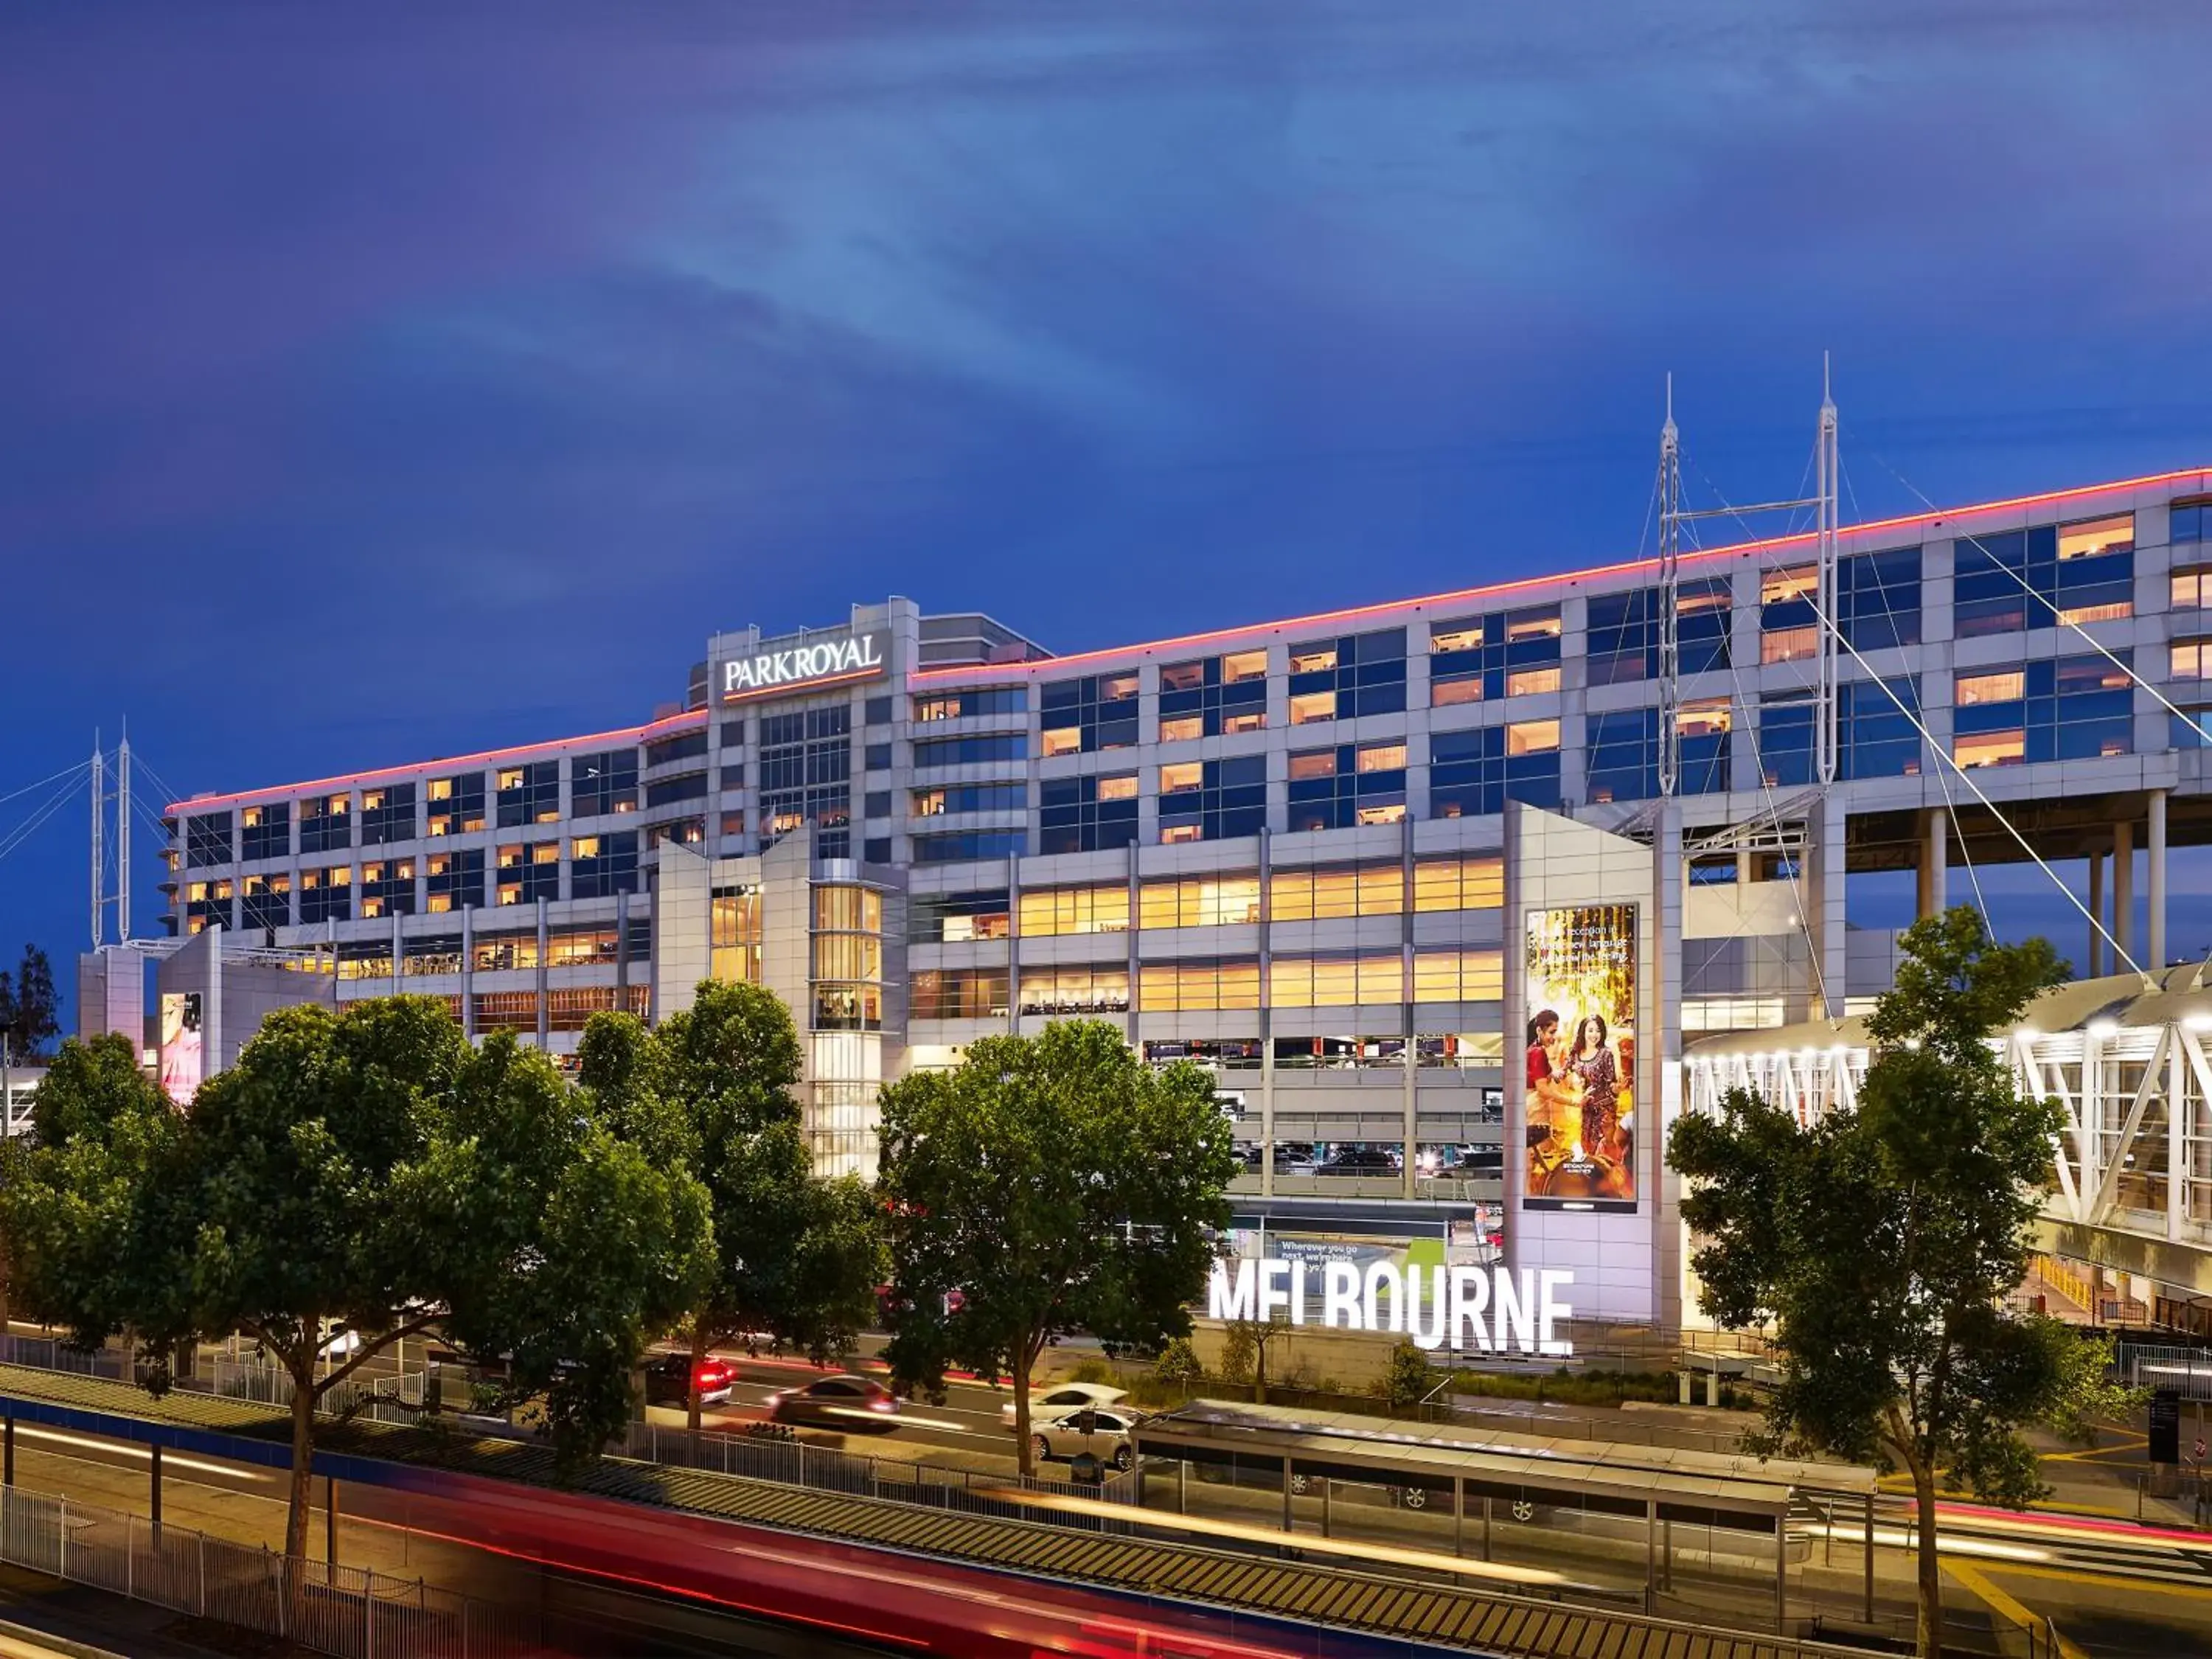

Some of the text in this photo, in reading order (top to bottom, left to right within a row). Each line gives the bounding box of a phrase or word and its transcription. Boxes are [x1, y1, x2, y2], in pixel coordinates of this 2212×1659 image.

[724, 635, 882, 692] PARKROYAL
[1281, 1241, 1357, 1256] Wherever you go
[1281, 1253, 1304, 1262] next,
